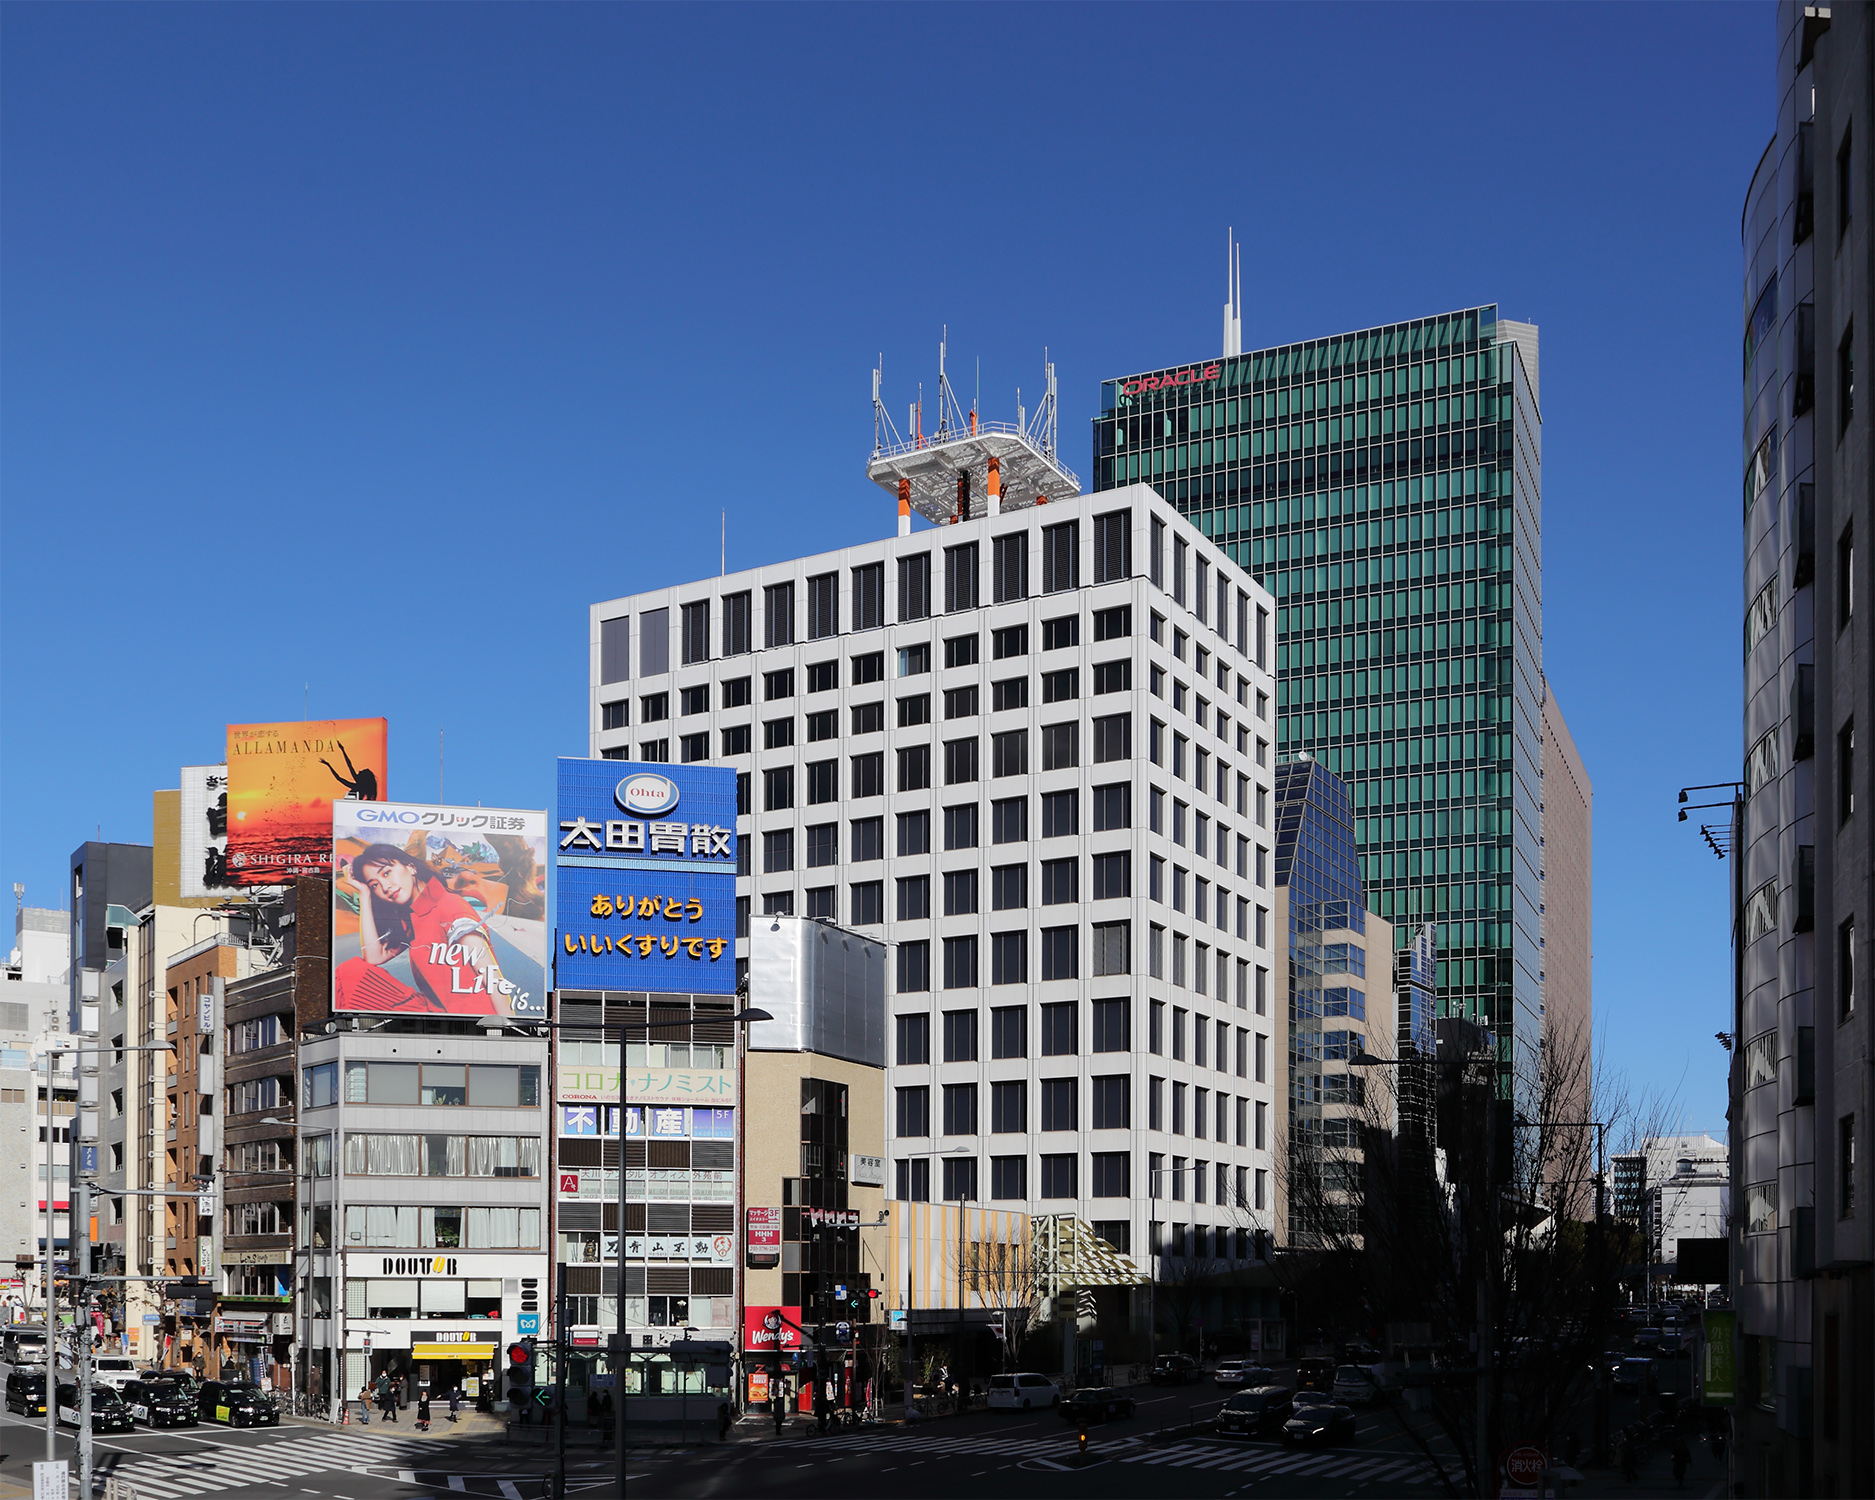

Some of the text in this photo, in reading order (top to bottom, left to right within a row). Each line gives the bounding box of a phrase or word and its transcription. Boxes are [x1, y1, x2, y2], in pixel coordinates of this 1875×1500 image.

[1123, 364, 1220, 395] ORACLE
[233, 730, 279, 739] 世界が恋する
[233, 740, 335, 755] ALLAMANDA
[630, 787, 665, 798] Ohta
[560, 816, 732, 854] 太田胃散
[250, 853, 311, 865] SHIGIRA
[591, 893, 703, 919] ありがとう
[565, 933, 728, 958] いいくすりです
[428, 942, 485, 966] new
[203, 996, 211, 1028] コヤノビル
[566, 1107, 683, 1135] 不動産
[716, 1111, 730, 1119] 5F
[860, 1158, 881, 1167] 美容室
[649, 1171, 686, 1179] オフィス
[692, 1171, 723, 1180] 外苑前
[768, 1209, 780, 1217] 3F
[383, 1256, 457, 1275] DOUTOR
[436, 1331, 476, 1342] DOUTOR
[752, 1327, 794, 1345] Wendy's
[1711, 1326, 1725, 1382] 外苑美人
[1511, 1459, 1543, 1472] 消火栓
